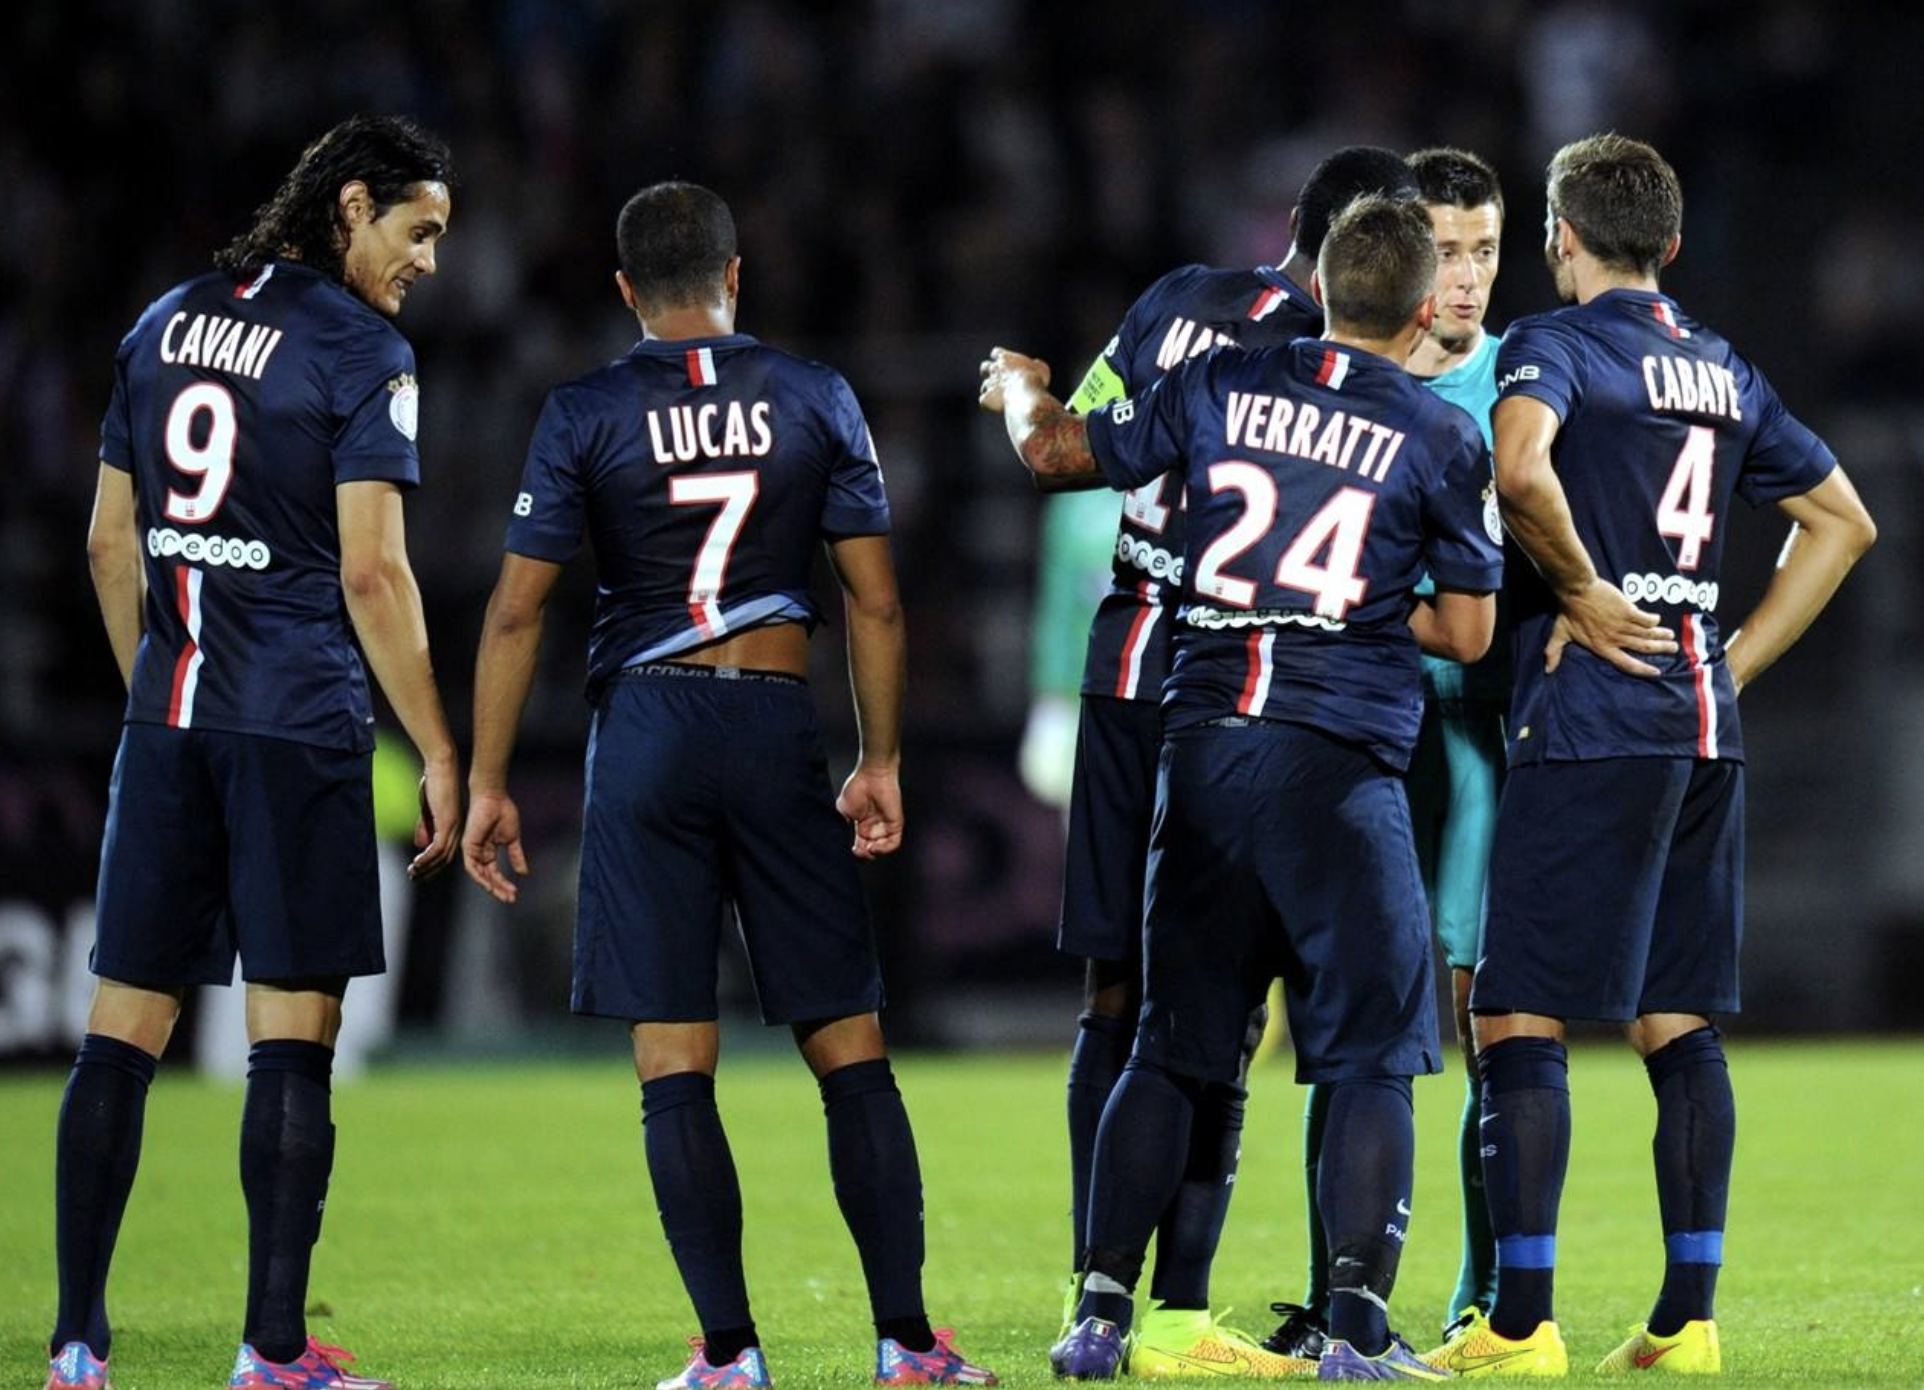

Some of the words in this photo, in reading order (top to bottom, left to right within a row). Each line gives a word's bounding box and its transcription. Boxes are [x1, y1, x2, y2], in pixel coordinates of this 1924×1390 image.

[160, 311, 282, 379] CAVANI
[1156, 317, 1236, 371] MA
[1642, 355, 1742, 422] CABAYE
[164, 381, 238, 524] 9
[647, 400, 772, 464] LUCAS
[1226, 390, 1406, 484] VERRATTI
[513, 492, 533, 516] B
[1655, 425, 1716, 571] 4
[669, 470, 759, 602] 7
[1194, 459, 1377, 621] 24
[1385, 1223, 1406, 1241] PA
